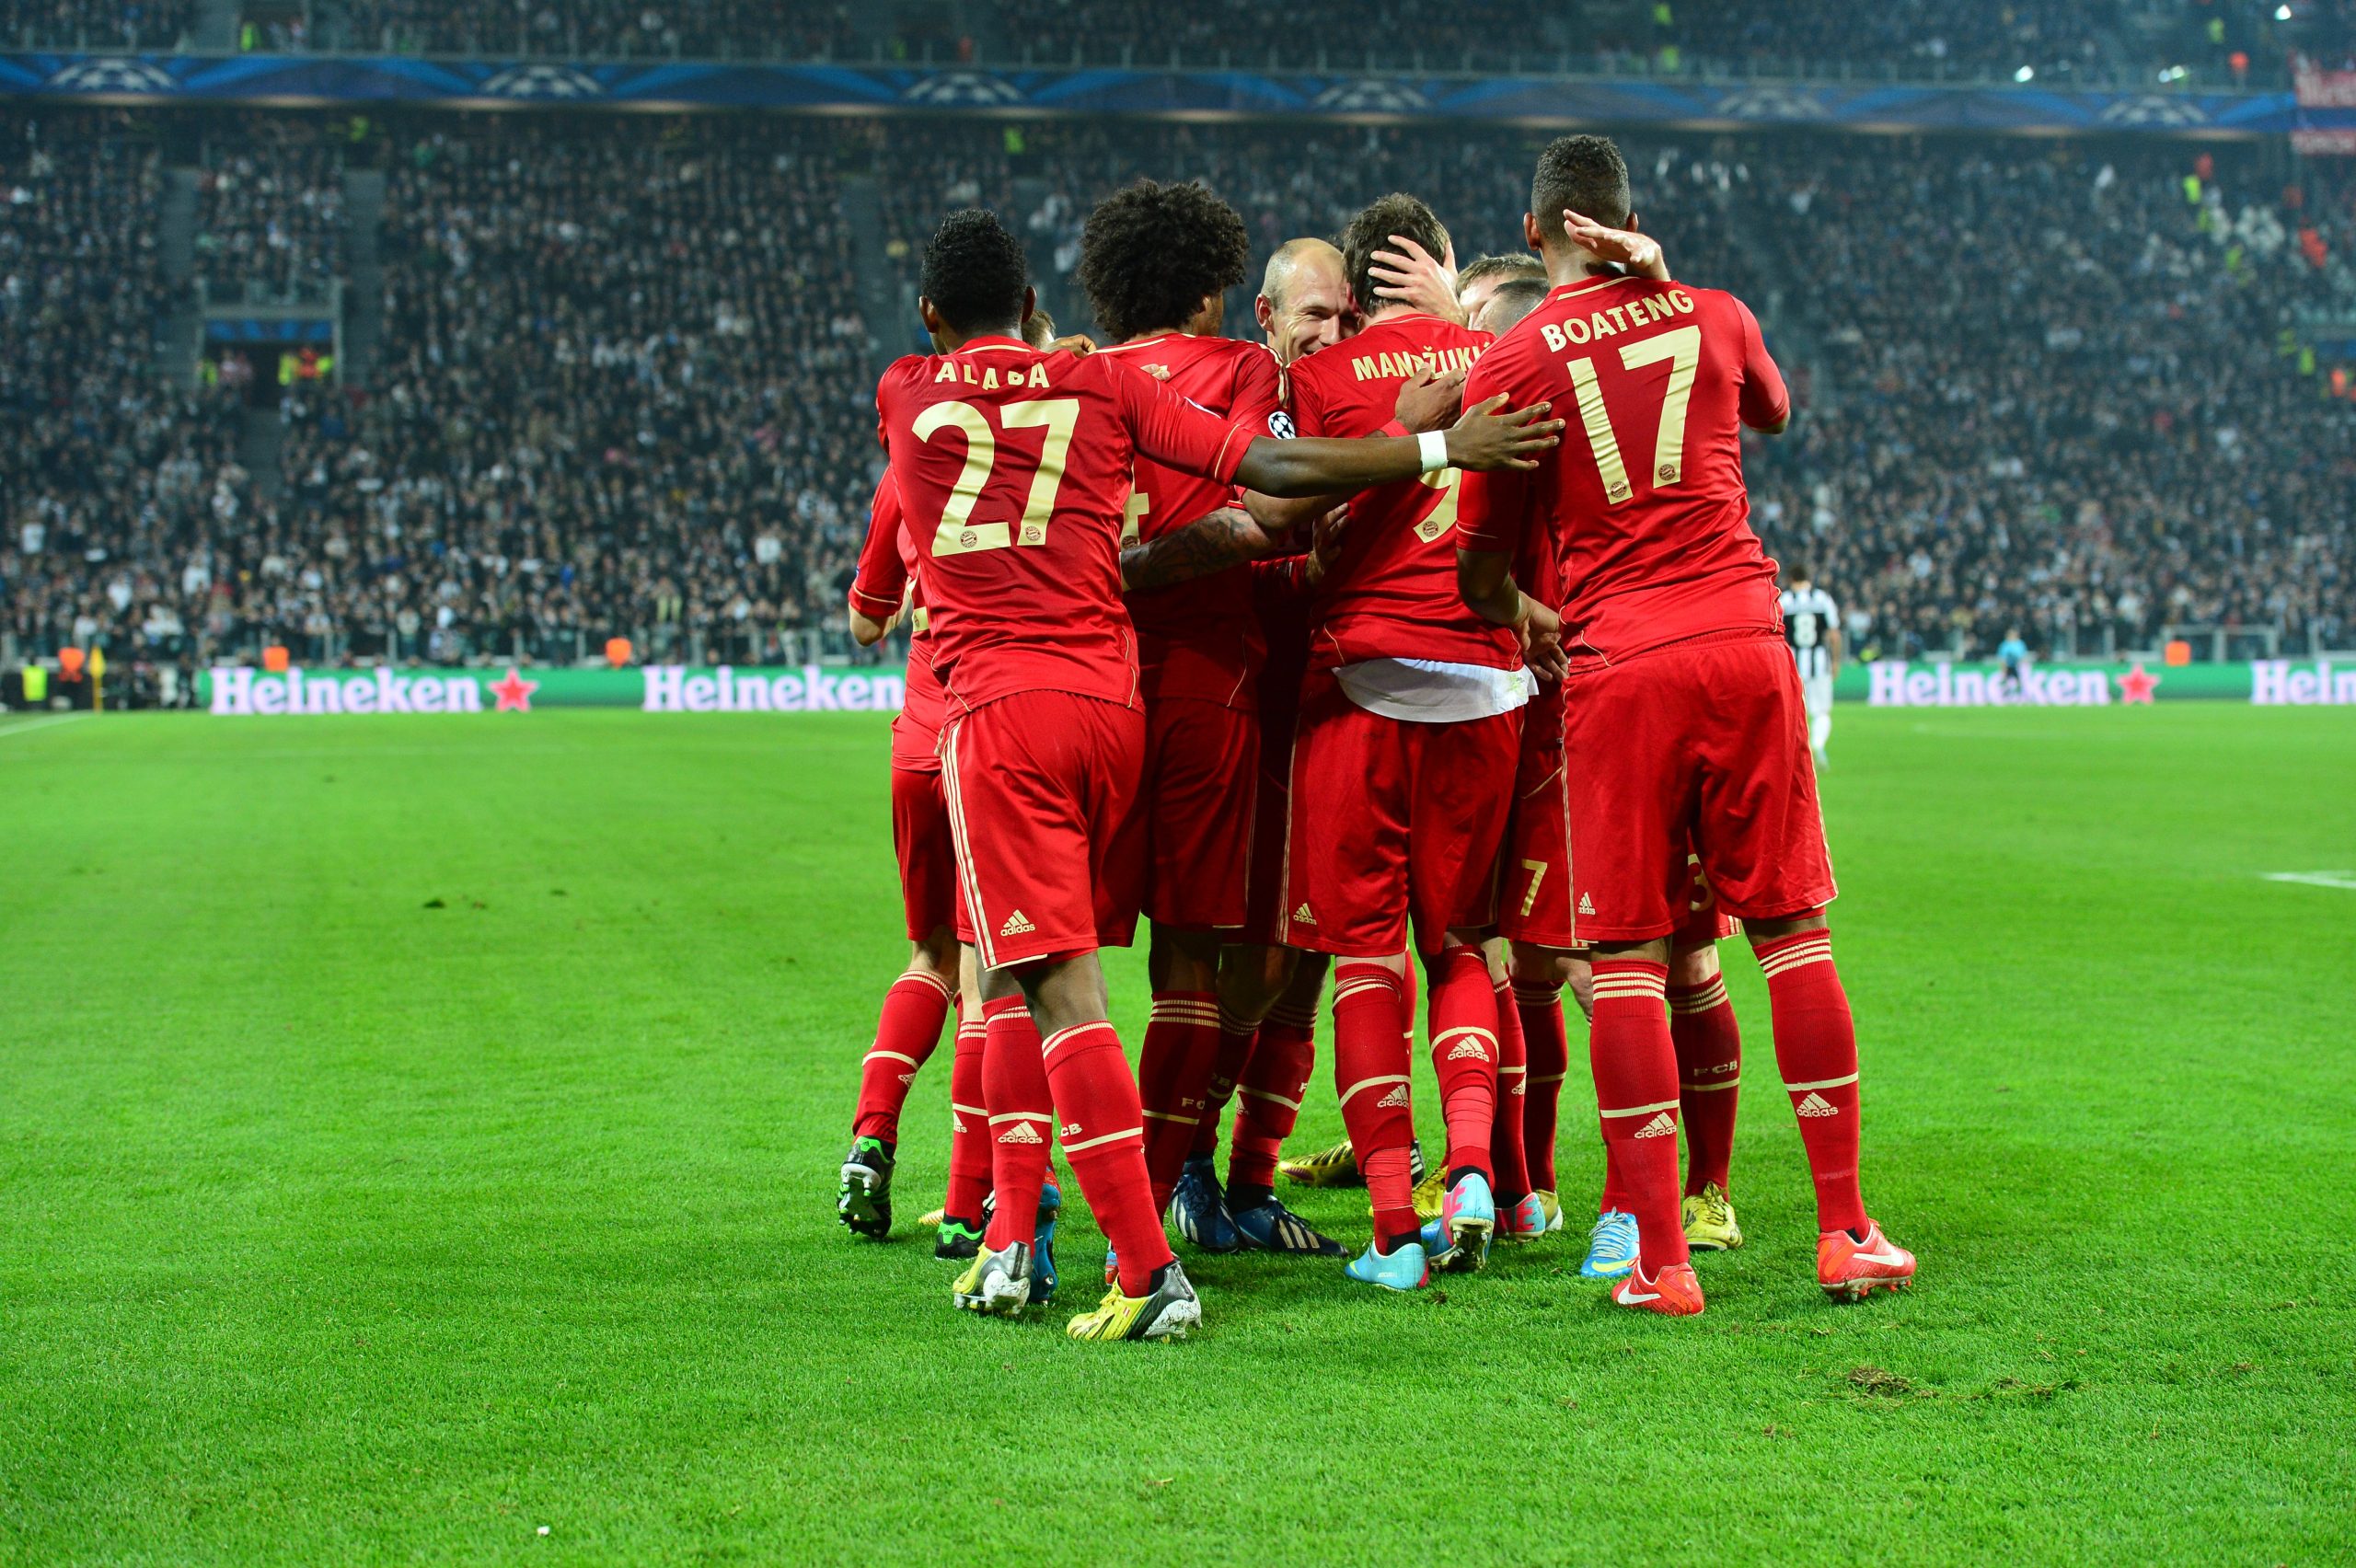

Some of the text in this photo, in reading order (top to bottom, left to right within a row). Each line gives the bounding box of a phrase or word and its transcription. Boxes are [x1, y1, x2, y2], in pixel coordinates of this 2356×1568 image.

[1540, 290, 1694, 353] BOATENG
[934, 362, 1050, 390] ALABA
[1351, 341, 1490, 382] MANDŽUKI
[1566, 325, 1702, 505] 17
[911, 398, 1080, 557] 27
[210, 667, 483, 714] Heineken
[641, 664, 907, 711] Heineken
[1520, 858, 1548, 917] 7
[999, 923, 1035, 937] adidas
[1292, 914, 1317, 926] adidas
[1448, 1049, 1490, 1063] adidas
[1796, 1105, 1839, 1118] adidas
[998, 1136, 1044, 1144] adidas
[1634, 1124, 1678, 1139] adidas
